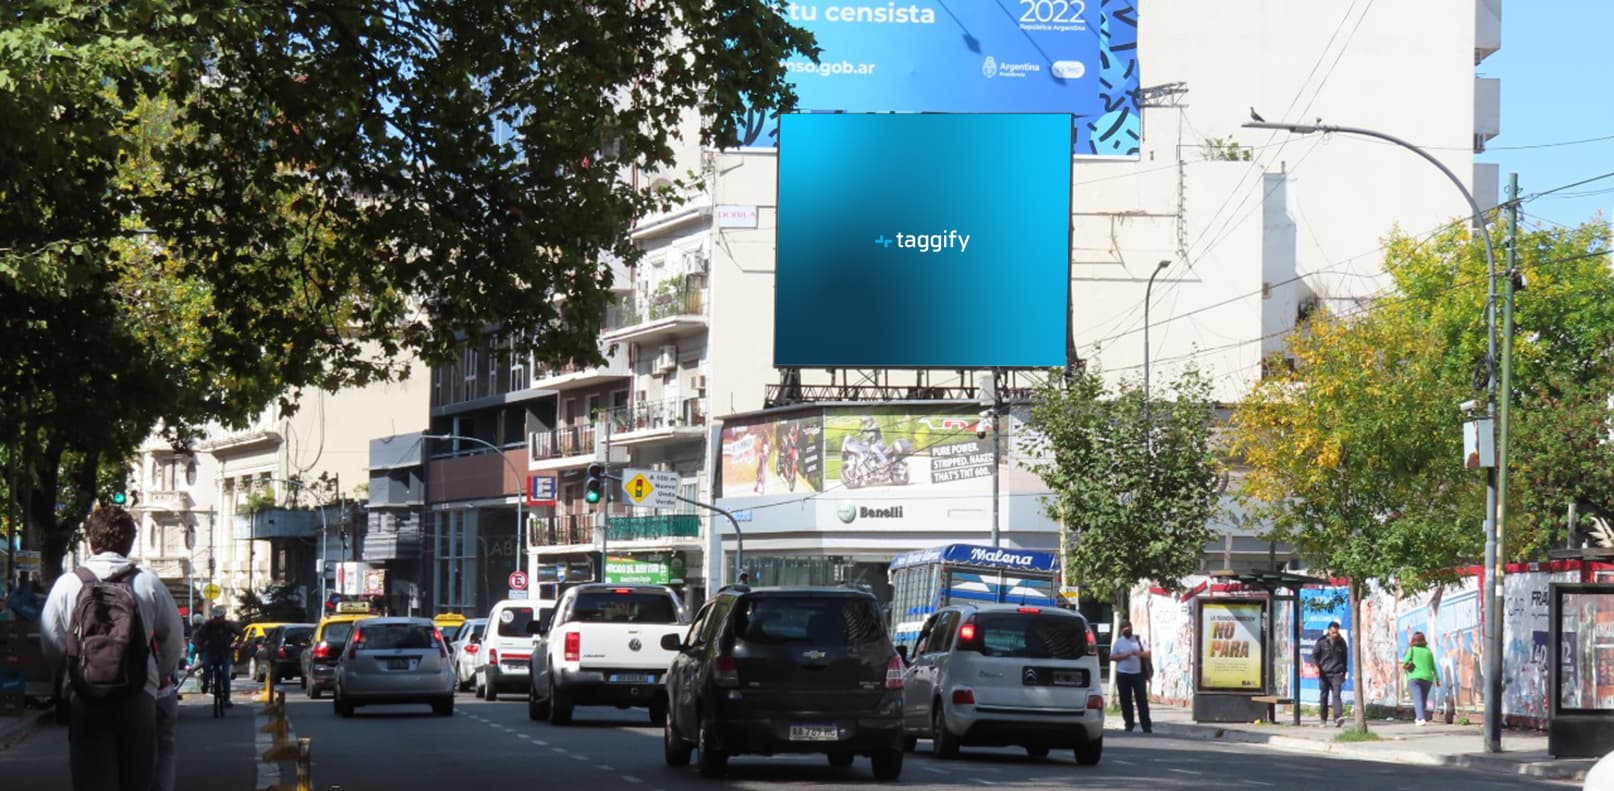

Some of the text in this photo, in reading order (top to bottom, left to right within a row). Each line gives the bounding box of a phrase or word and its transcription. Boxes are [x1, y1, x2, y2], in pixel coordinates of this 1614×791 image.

[790, 2, 936, 24] tu censista
[1019, 0, 1086, 22] 2022
[896, 229, 970, 253] taggify
[932, 442, 979, 457] PURE POWER.
[934, 456, 969, 469] STRIPPED.
[859, 506, 903, 518] Benelli
[970, 547, 1033, 565] Malena
[1213, 622, 1236, 640] NO
[1209, 640, 1250, 658] PARA
